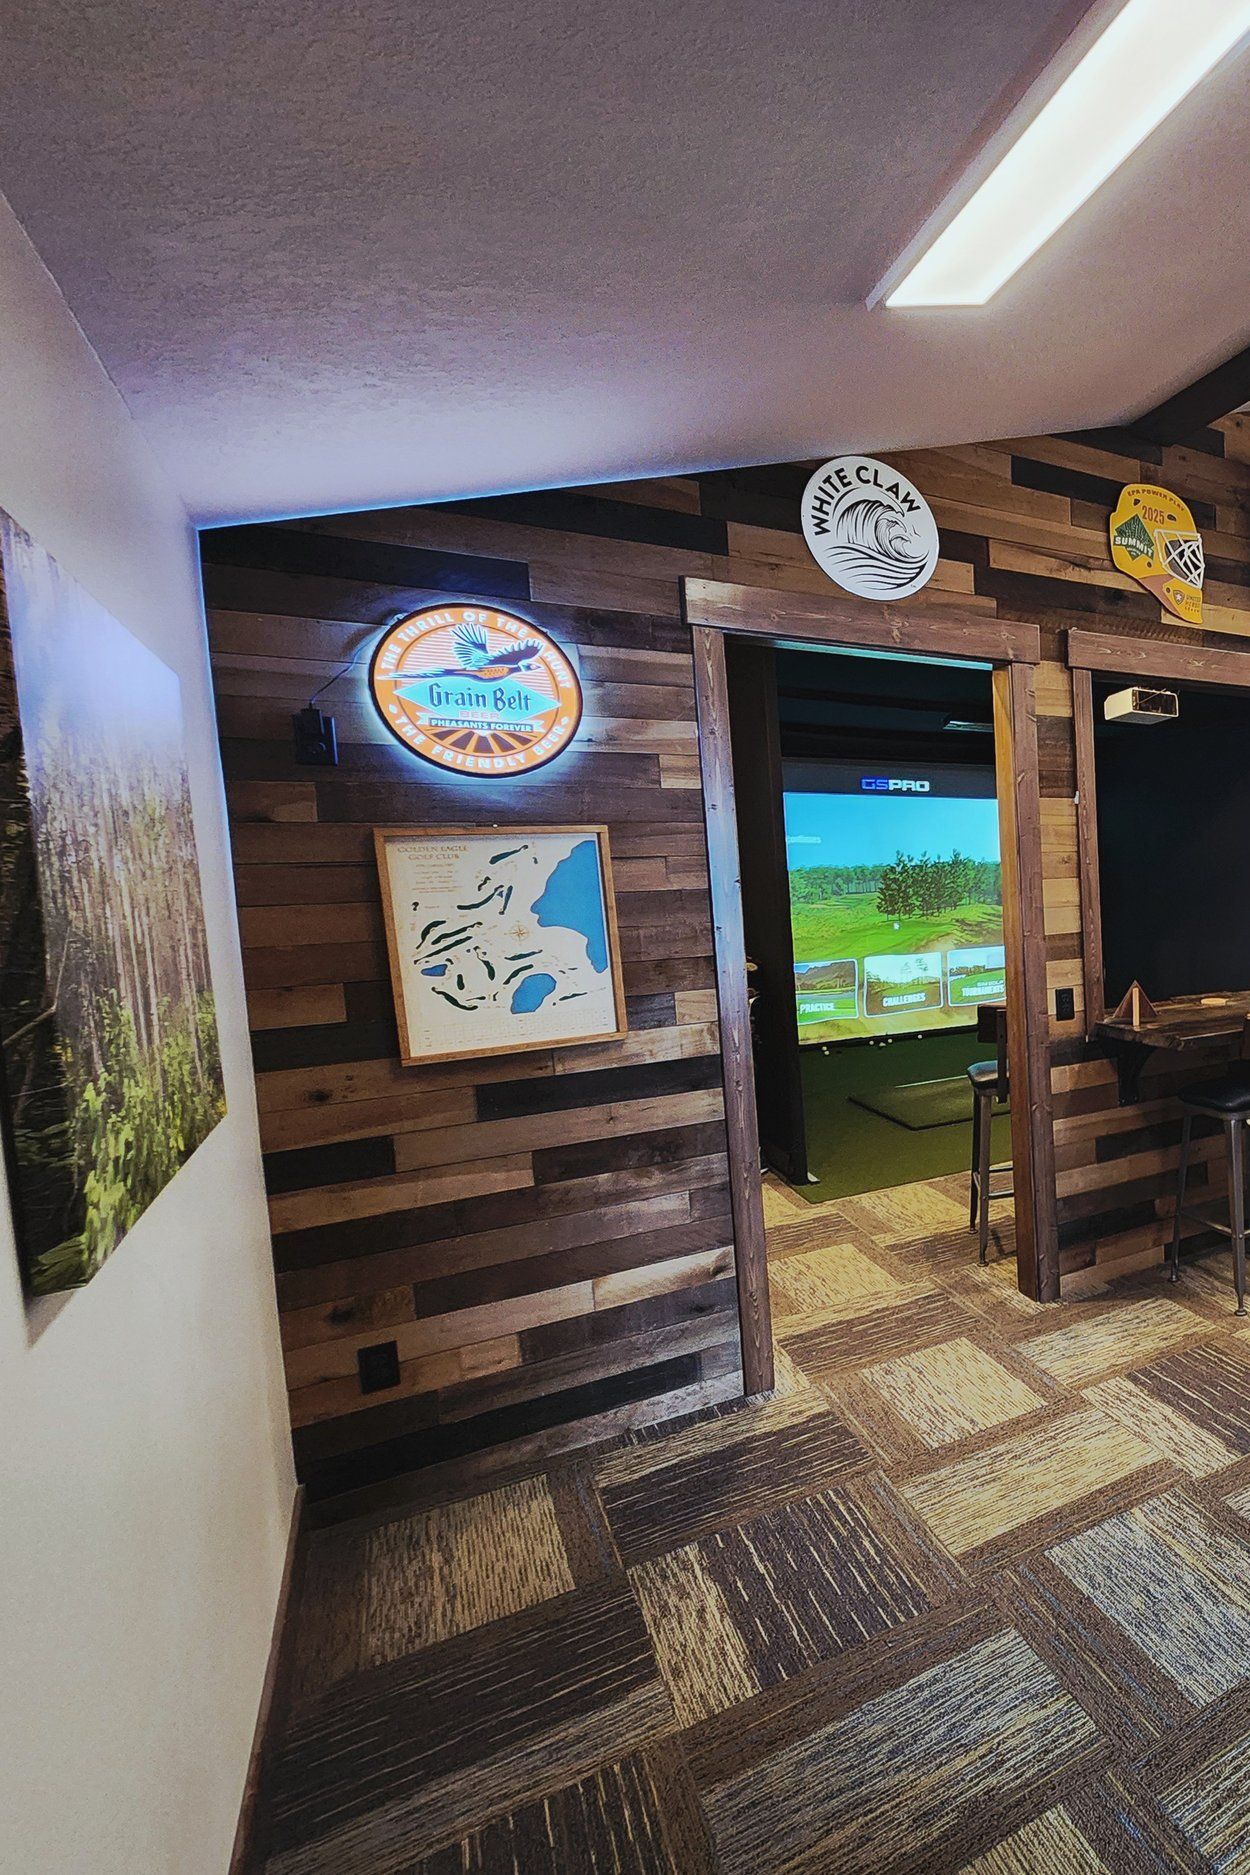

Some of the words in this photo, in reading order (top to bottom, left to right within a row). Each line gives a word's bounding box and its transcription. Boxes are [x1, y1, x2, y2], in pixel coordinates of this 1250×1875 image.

[811, 467, 853, 536] WHITE
[855, 465, 921, 512] CLAW
[1142, 505, 1165, 525] 2025
[1115, 536, 1153, 557] SUMMIT
[381, 643, 401, 671] THE
[398, 612, 454, 641] THRILL
[462, 611, 487, 623] OF
[496, 616, 530, 638] THE
[545, 650, 571, 688] HUNT
[428, 682, 487, 708] Grain
[493, 687, 531, 712] Belt
[430, 719, 489, 731] PHEASANTS
[490, 722, 533, 732] FOREVER
[394, 716, 427, 745] THE
[431, 743, 526, 769] FRIENDLY
[533, 726, 563, 755] BEER
[861, 778, 930, 792] GSPRO
